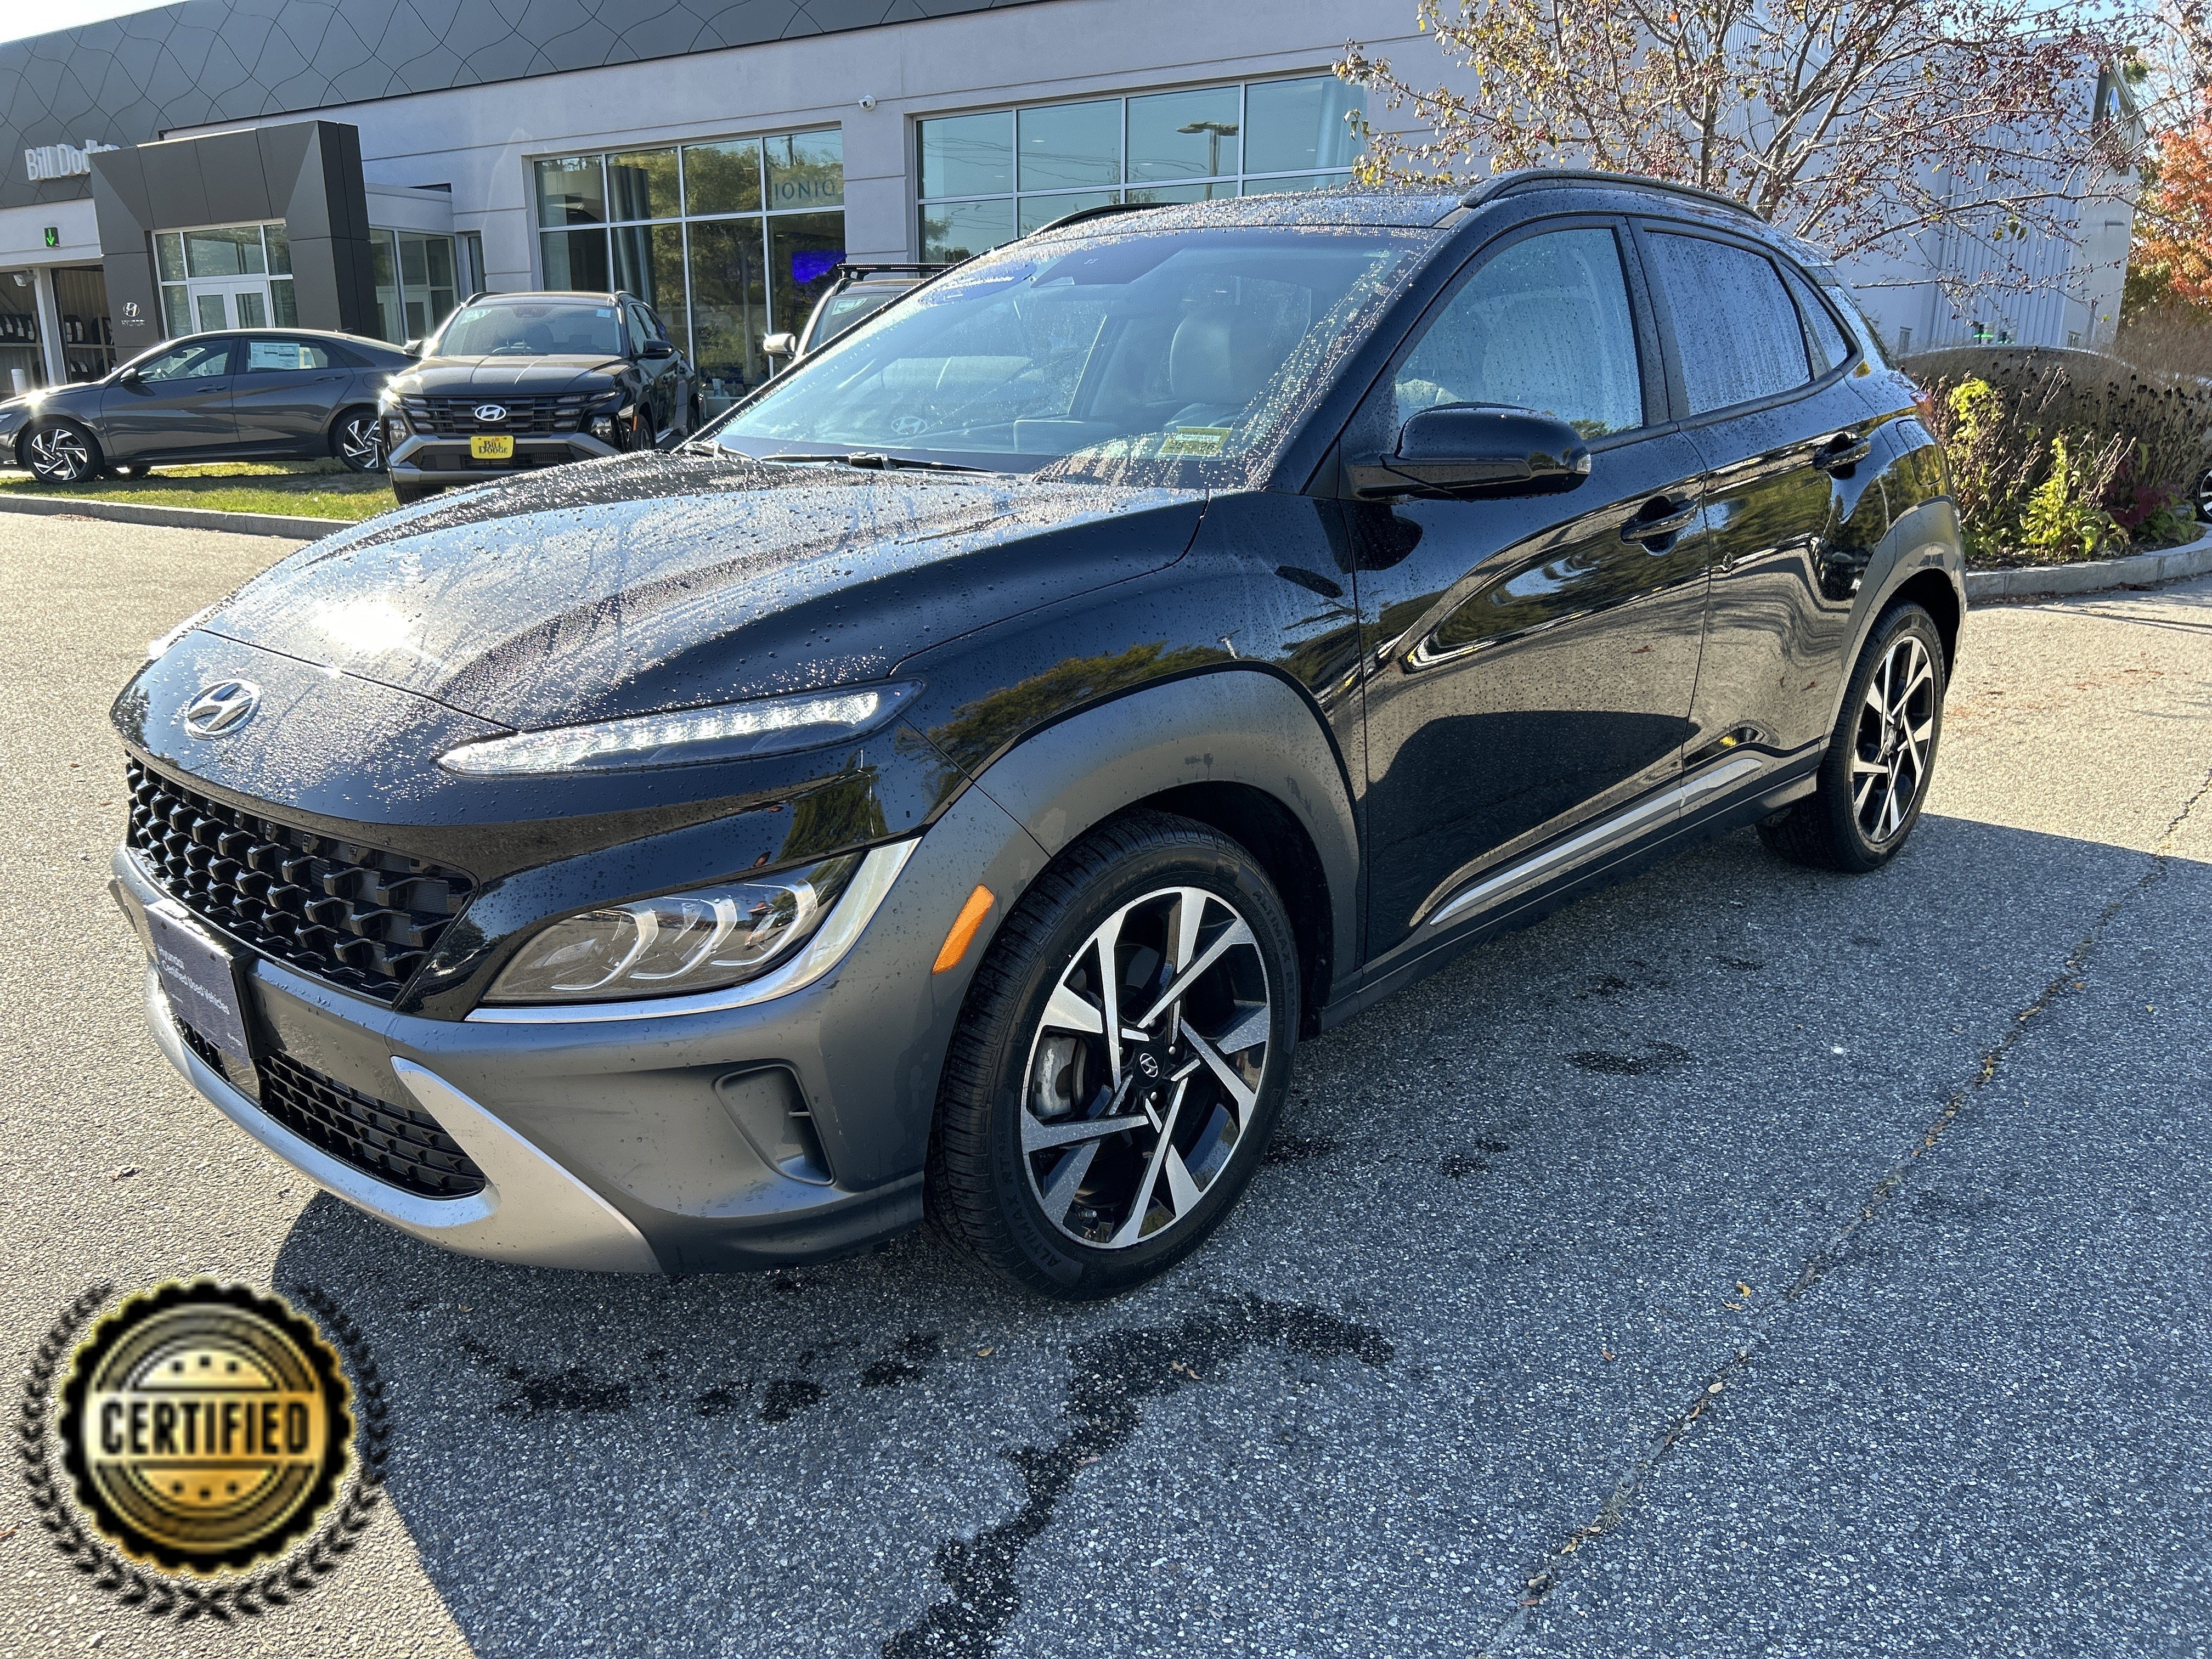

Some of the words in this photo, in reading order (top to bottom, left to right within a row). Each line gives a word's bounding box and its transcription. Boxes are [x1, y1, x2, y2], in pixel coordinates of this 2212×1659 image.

[25, 146, 60, 180] Bill
[774, 178, 836, 201] IONIQ
[187, 975, 205, 997] Used
